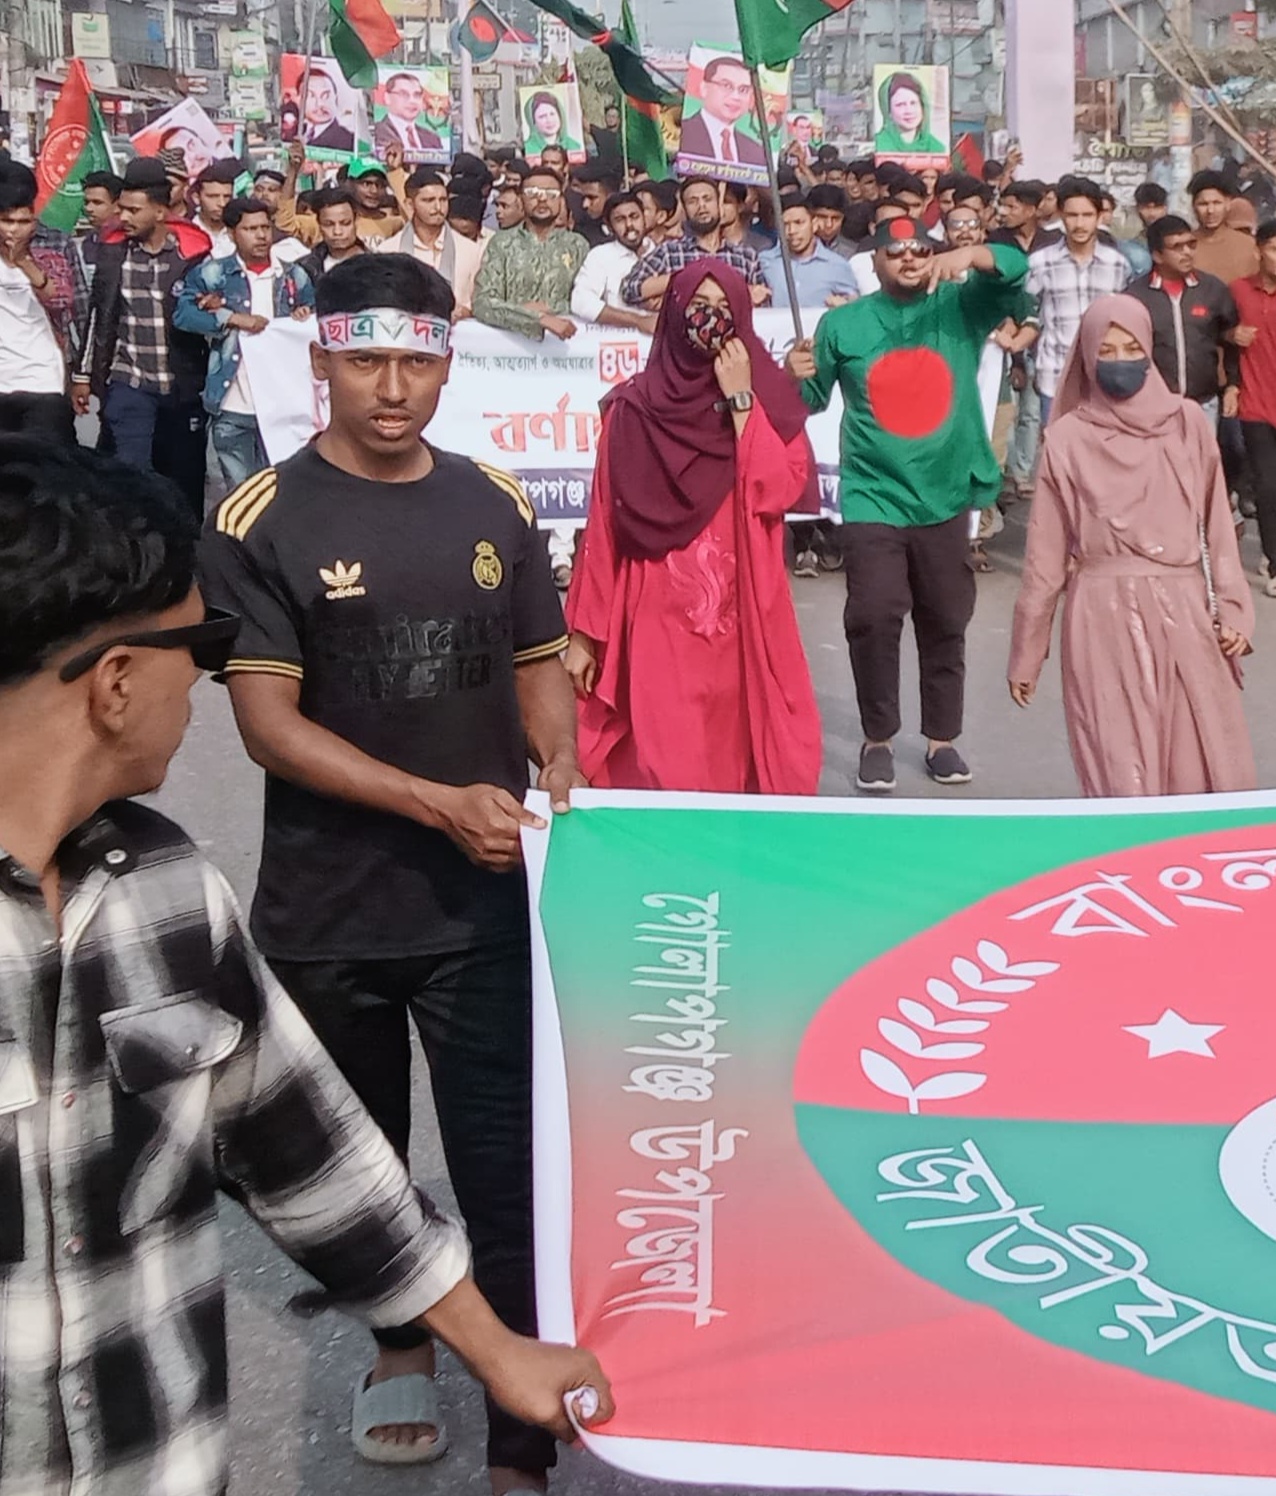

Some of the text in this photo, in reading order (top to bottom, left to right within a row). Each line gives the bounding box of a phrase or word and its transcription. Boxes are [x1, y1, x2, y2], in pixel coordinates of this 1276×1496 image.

[327, 314, 448, 348] ছাত্র দল
[541, 356, 549, 369] ও
[325, 586, 366, 600] adidas
[600, 890, 749, 1329] গোলাপগঞ্জ উপজেলা
